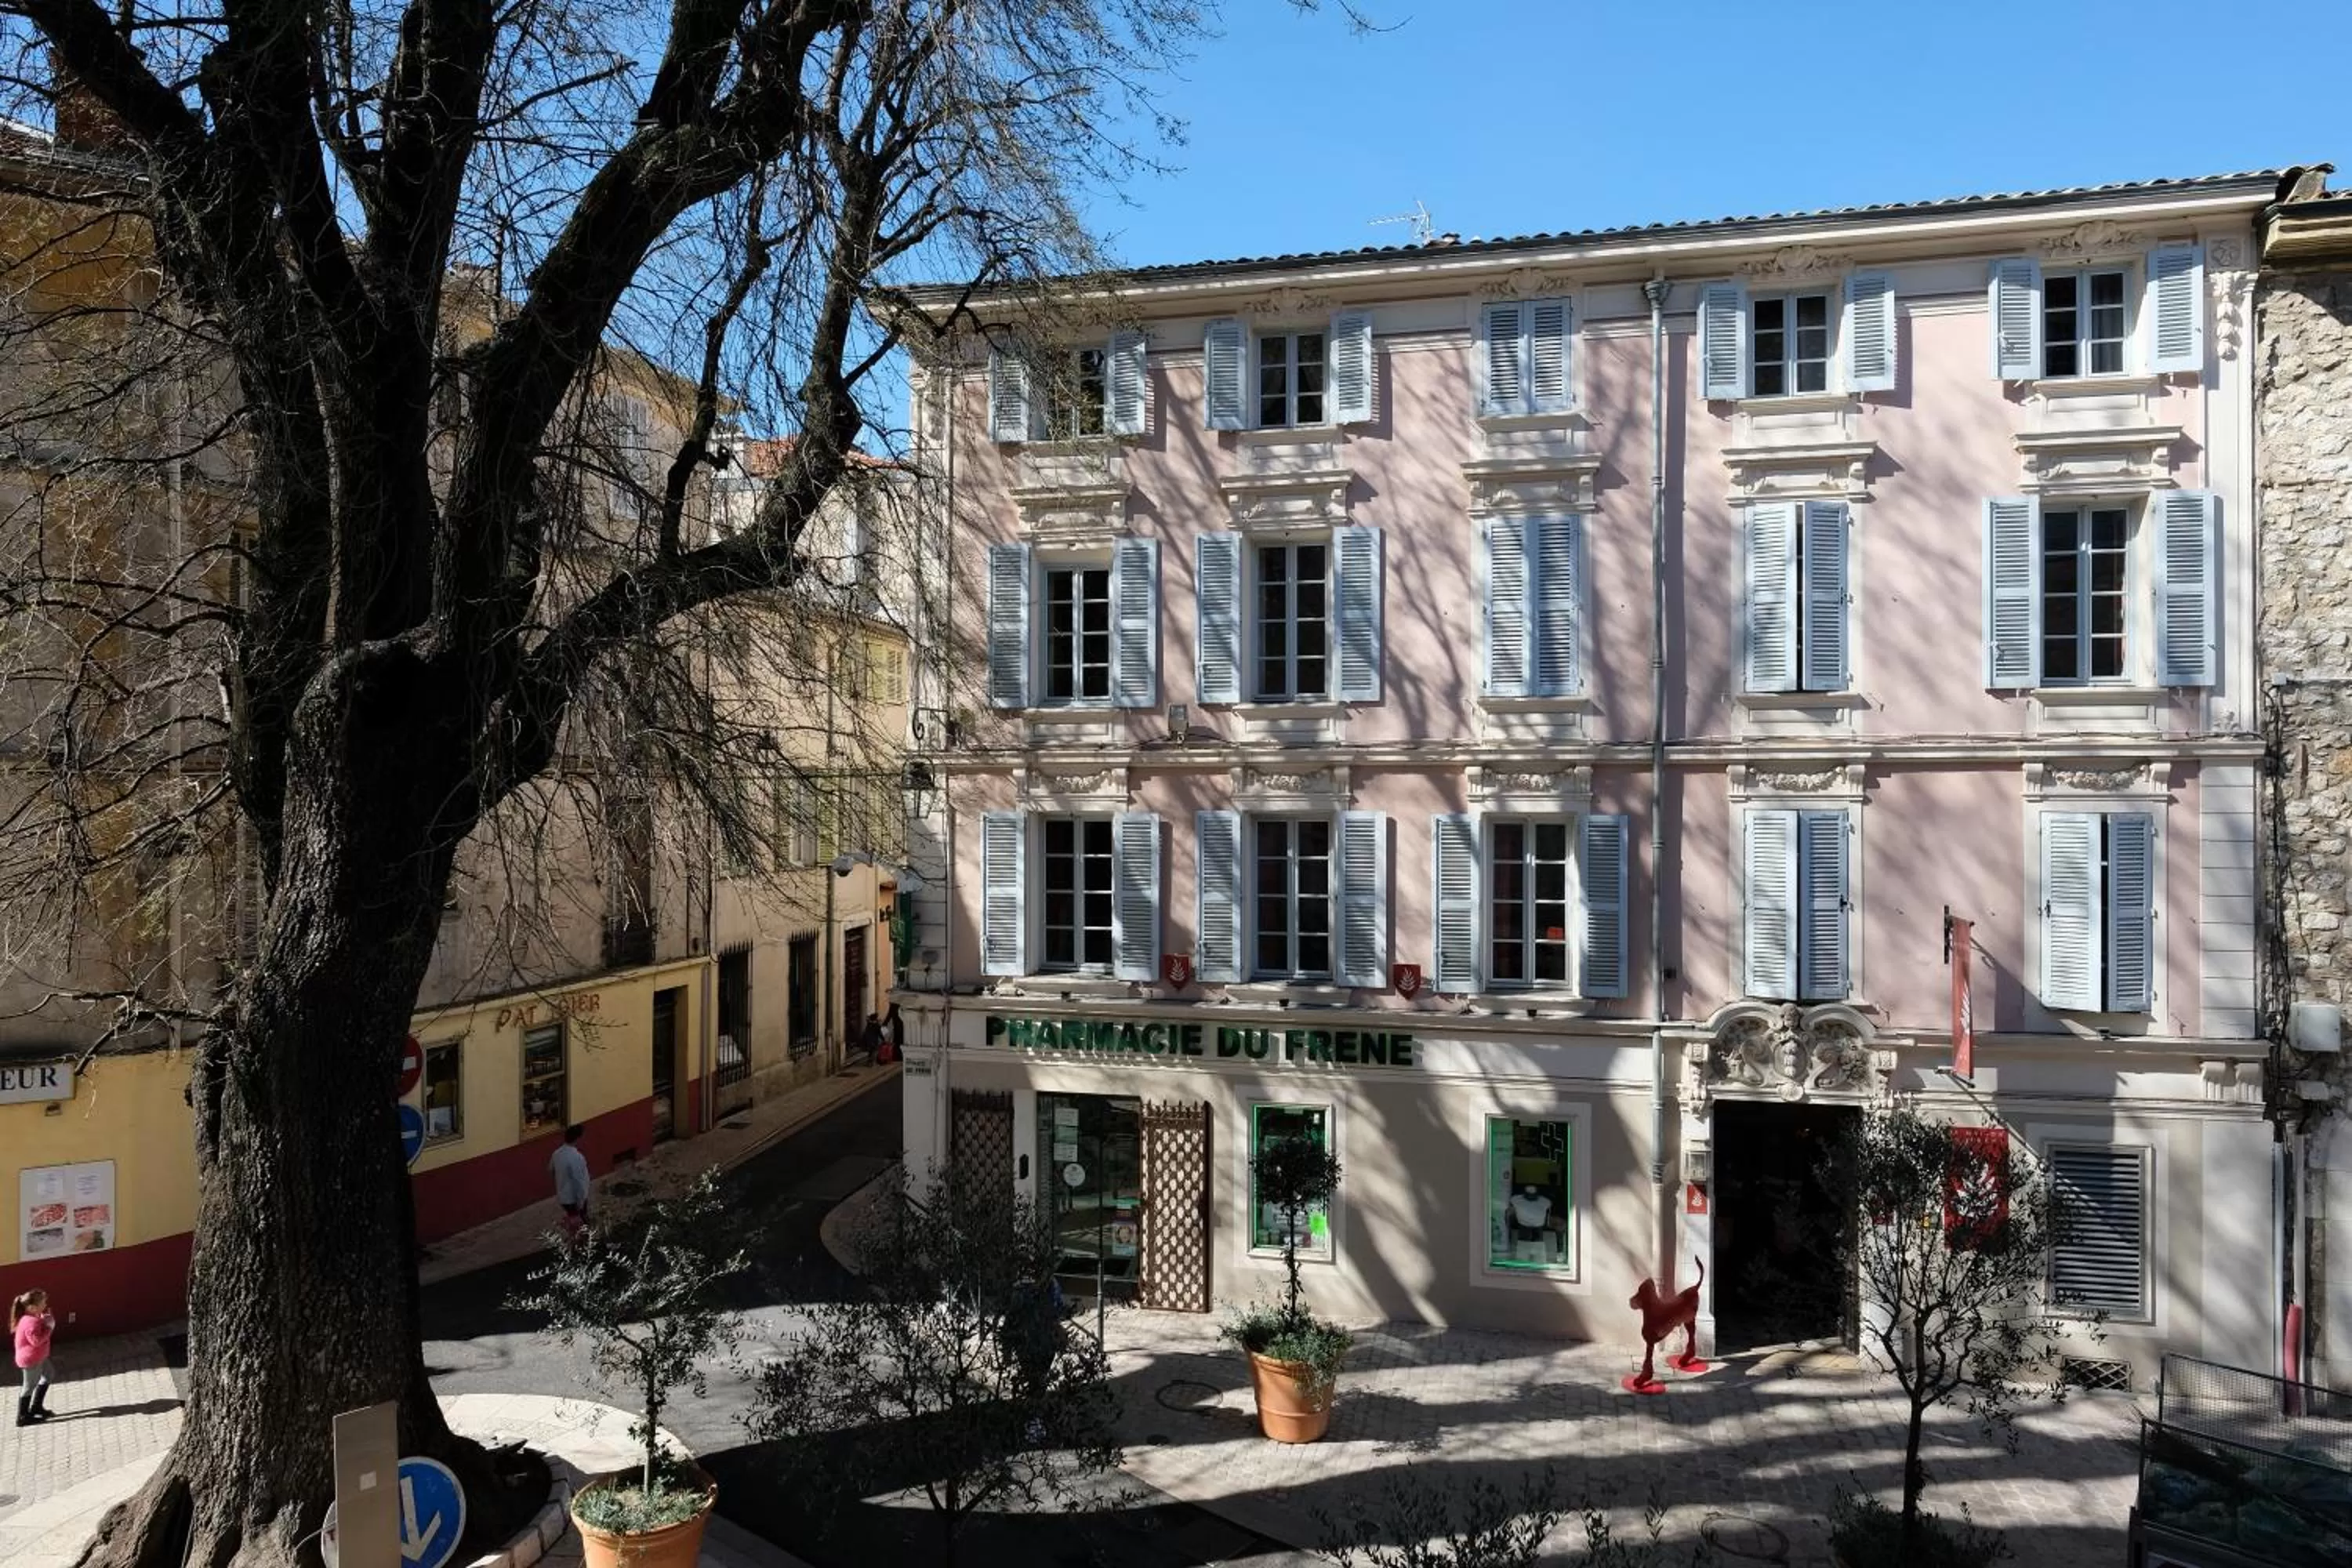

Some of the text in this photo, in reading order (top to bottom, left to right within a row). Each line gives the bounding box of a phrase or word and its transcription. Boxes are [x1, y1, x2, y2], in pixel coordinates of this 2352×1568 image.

[985, 1015, 1414, 1065] PHARMACIE DU FRENE
[0, 1066, 58, 1091] EUR
